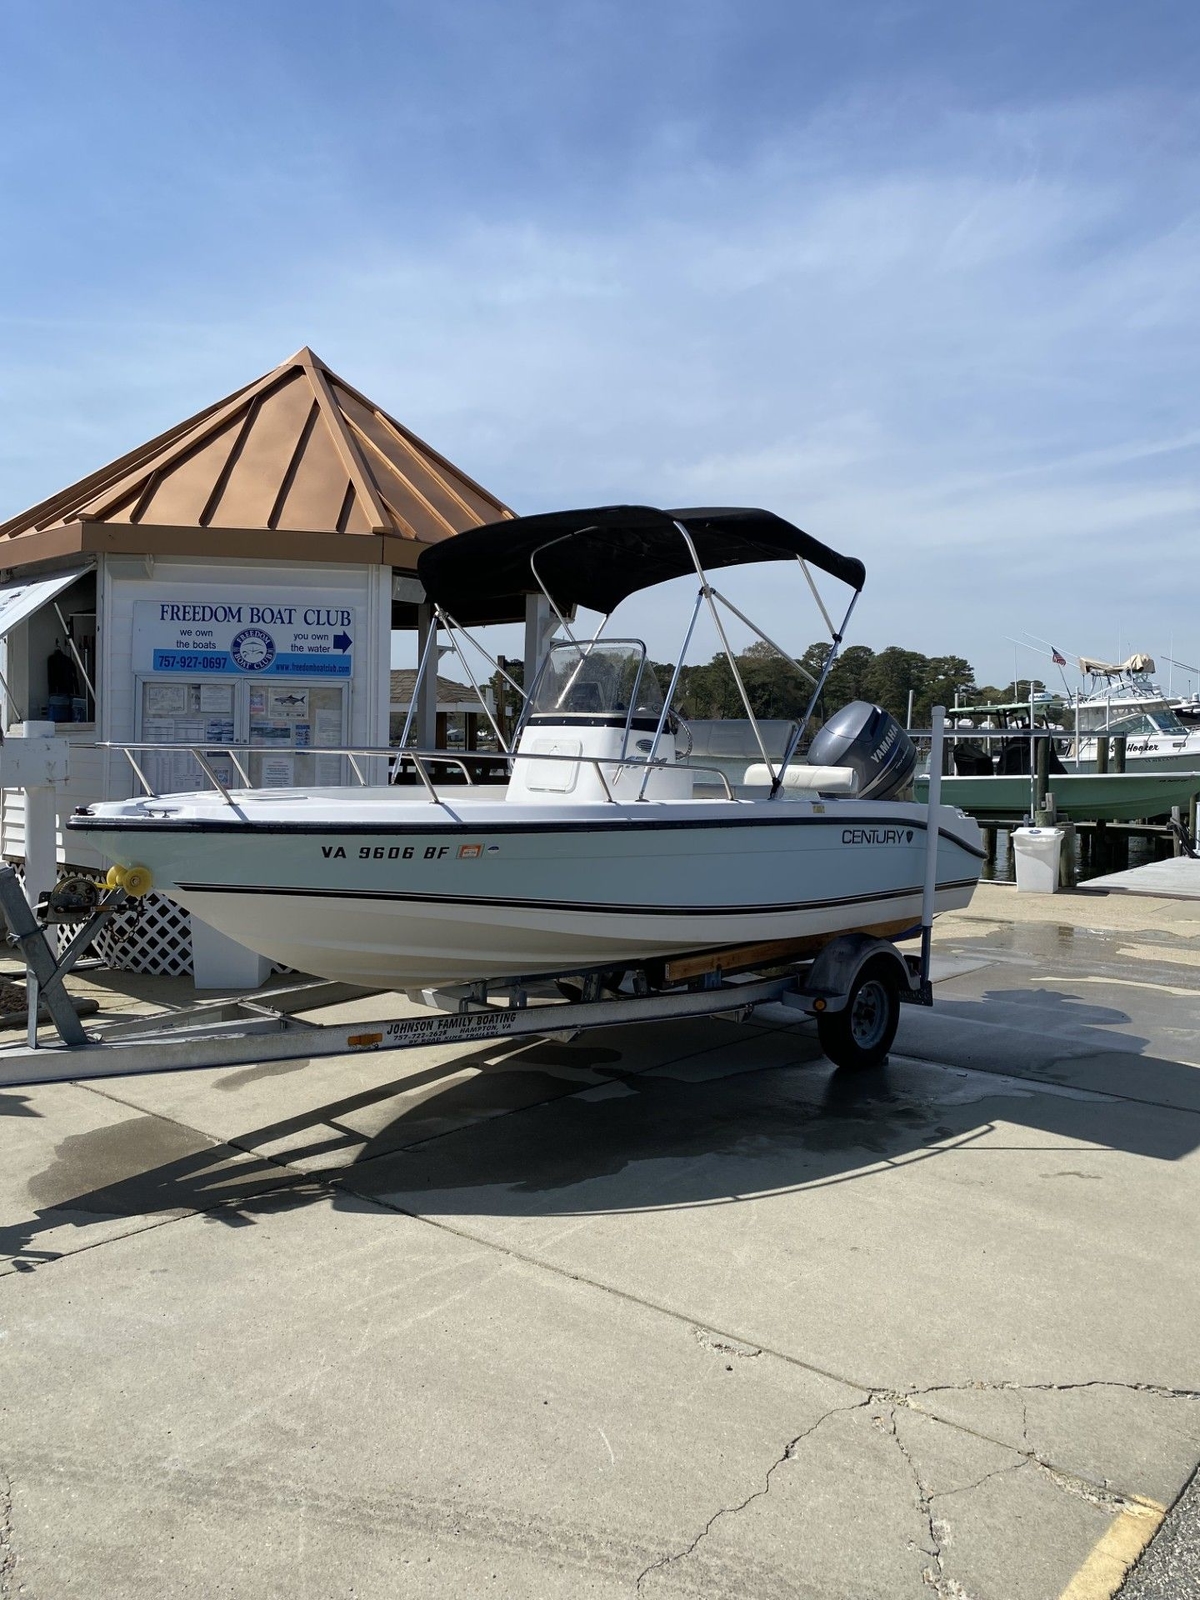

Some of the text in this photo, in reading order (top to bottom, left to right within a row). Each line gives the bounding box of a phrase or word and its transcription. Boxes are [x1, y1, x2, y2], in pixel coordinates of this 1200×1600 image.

[160, 604, 352, 627] FREEDOM BOAT CLUB
[180, 629, 213, 637] we own
[236, 630, 271, 645] FREEDOM
[293, 632, 329, 641] you own
[176, 640, 217, 650] the boats
[291, 644, 331, 653] the water
[159, 655, 227, 670] 757-927-0697
[234, 653, 273, 669] BOAT CLUB
[275, 662, 350, 673] www.freedomboatclub.com
[870, 724, 899, 763] YAMAHA
[841, 829, 905, 844] CENTURY
[321, 846, 347, 859] VA
[358, 846, 415, 859] 9606
[423, 846, 450, 859] BF
[386, 1012, 517, 1035] JOHNSON FAMILY BOATING
